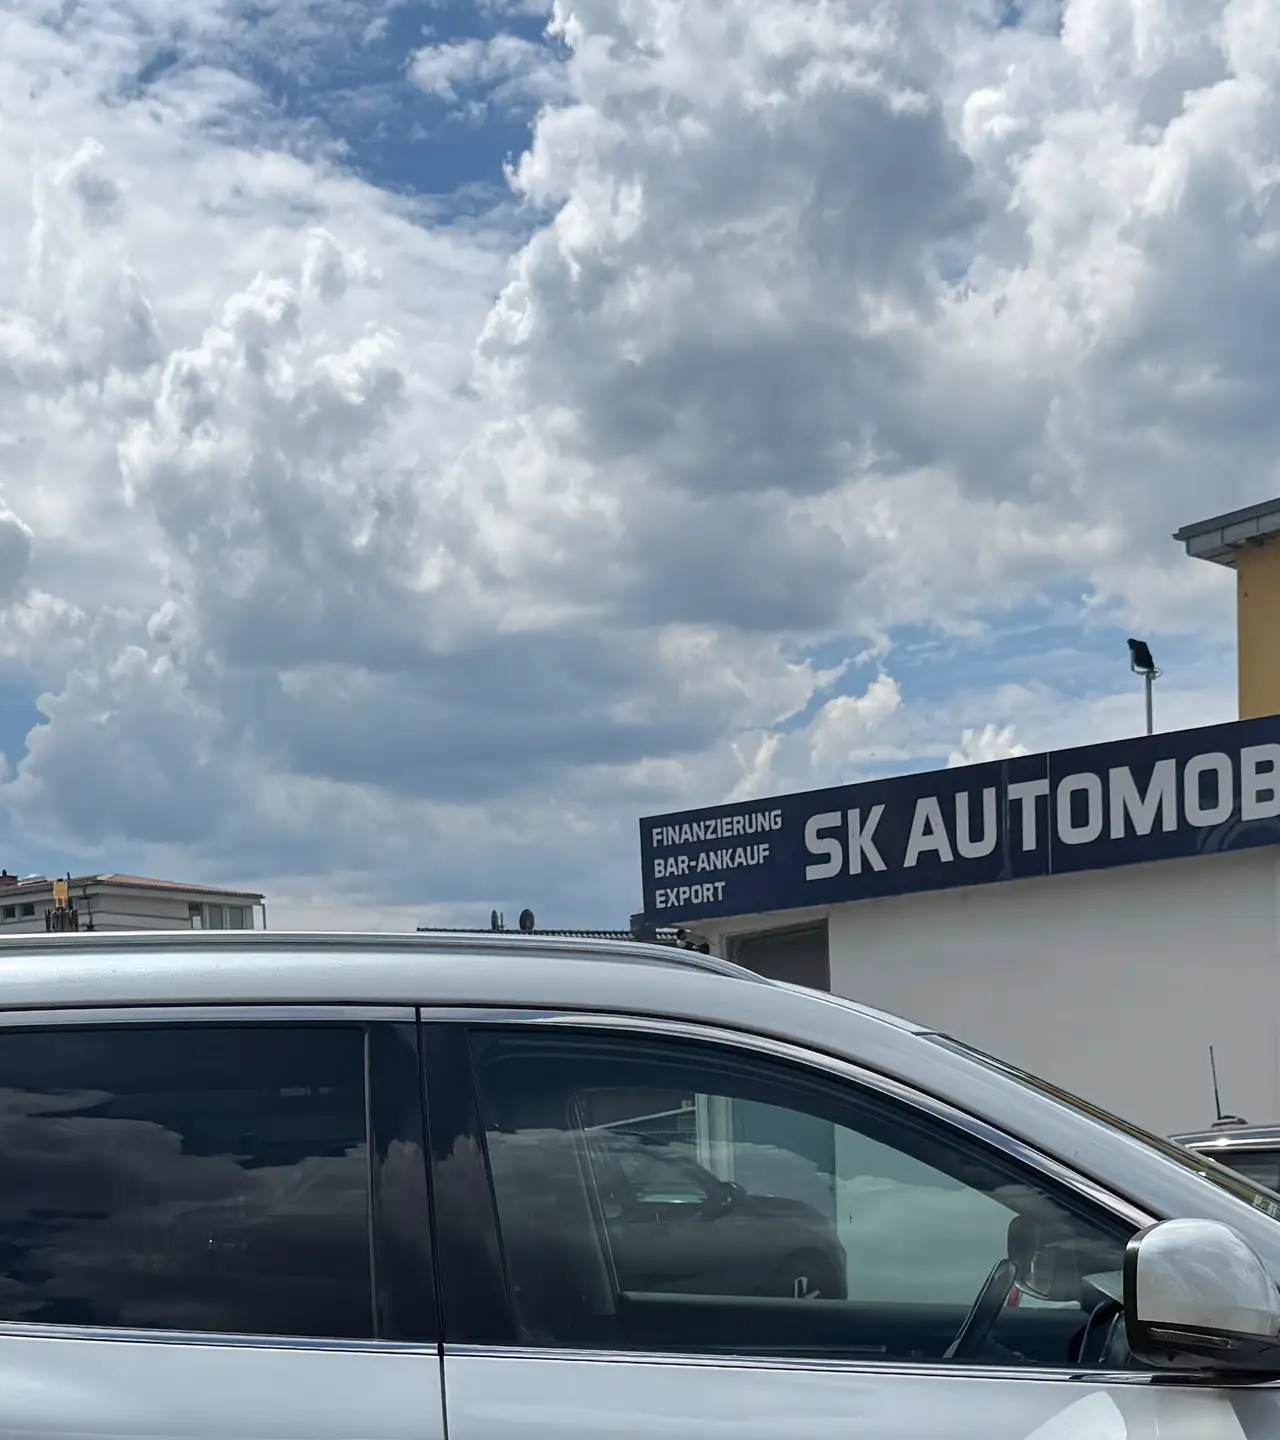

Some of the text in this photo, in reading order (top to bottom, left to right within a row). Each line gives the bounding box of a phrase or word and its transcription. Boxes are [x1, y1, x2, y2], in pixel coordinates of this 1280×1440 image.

[652, 809, 782, 847] FINANZIERUNG
[804, 804, 887, 881] SK
[654, 844, 770, 878] BAR-ANKAUF
[655, 881, 726, 908] EXPORT
